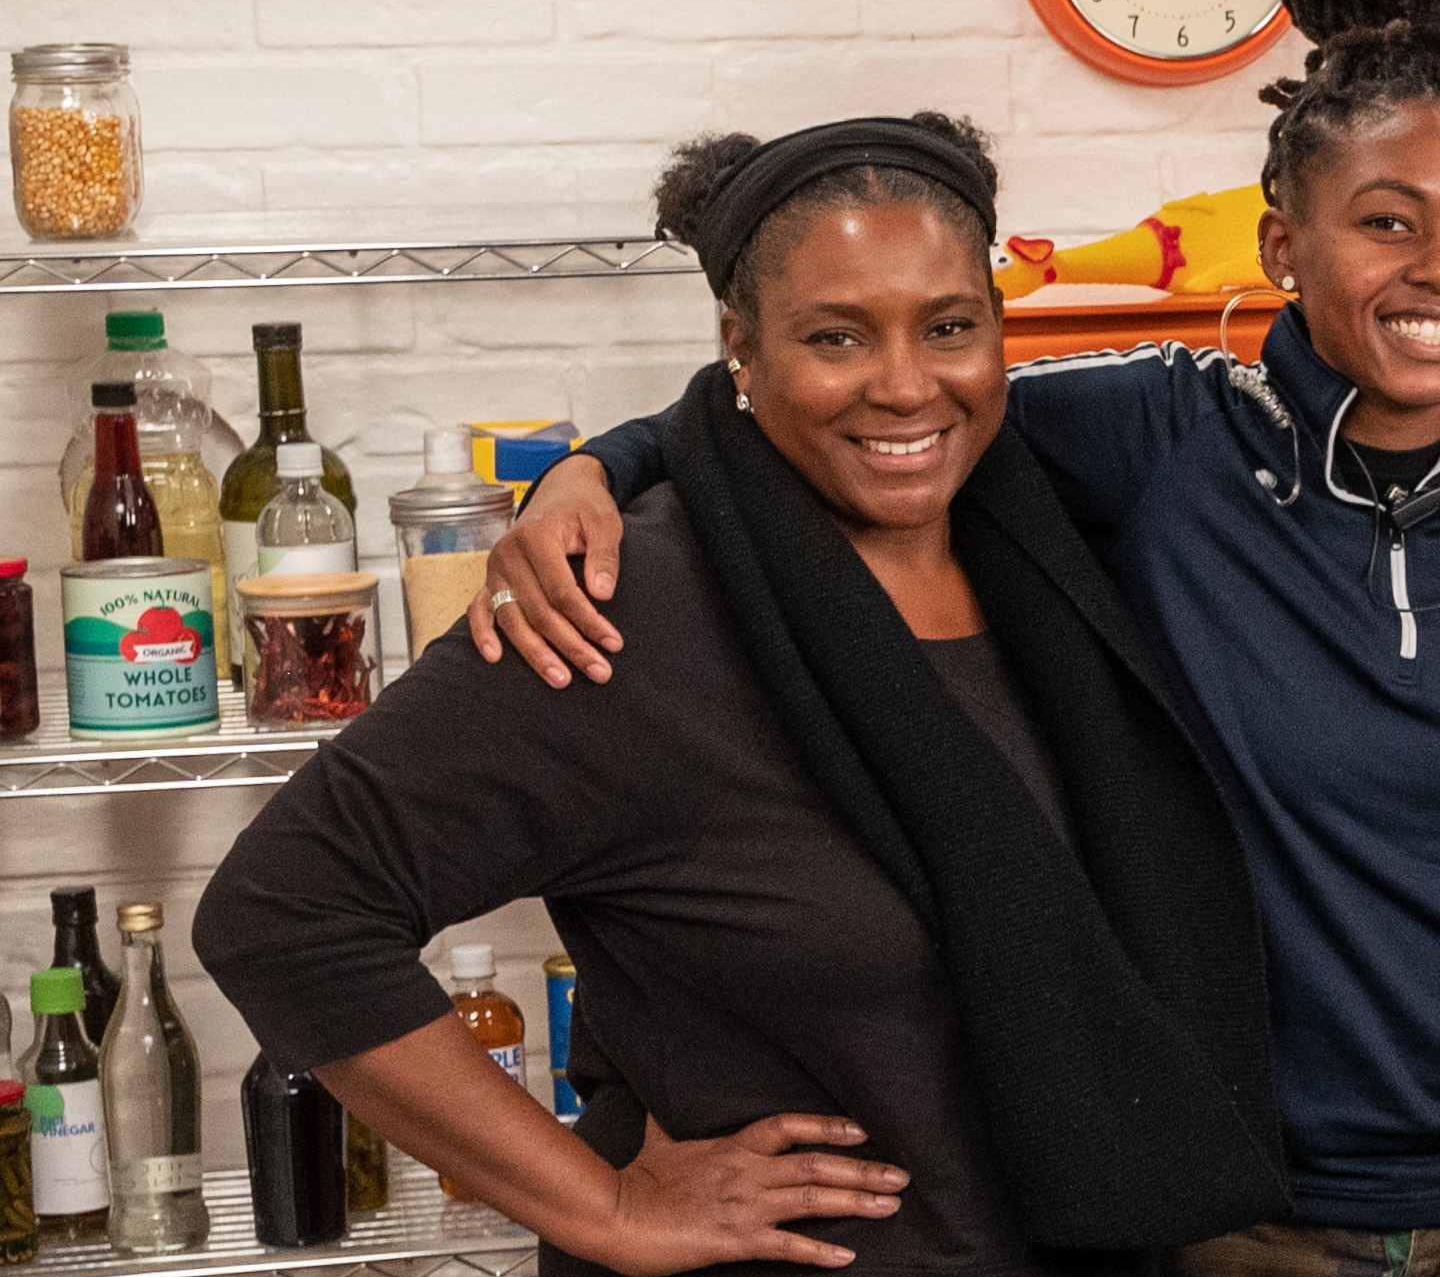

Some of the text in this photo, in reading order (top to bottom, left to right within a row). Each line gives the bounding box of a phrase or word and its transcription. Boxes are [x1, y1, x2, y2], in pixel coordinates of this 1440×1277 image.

[1127, 15, 1139, 38] 7
[1225, 10, 1236, 33] 5
[1177, 25, 1189, 47] 6
[100, 589, 201, 616] 100% NATURAL
[142, 646, 187, 658] ORGANIC
[124, 666, 192, 686] WHOLE
[106, 686, 207, 709] TOMATOES
[491, 1048, 520, 1068] PLE
